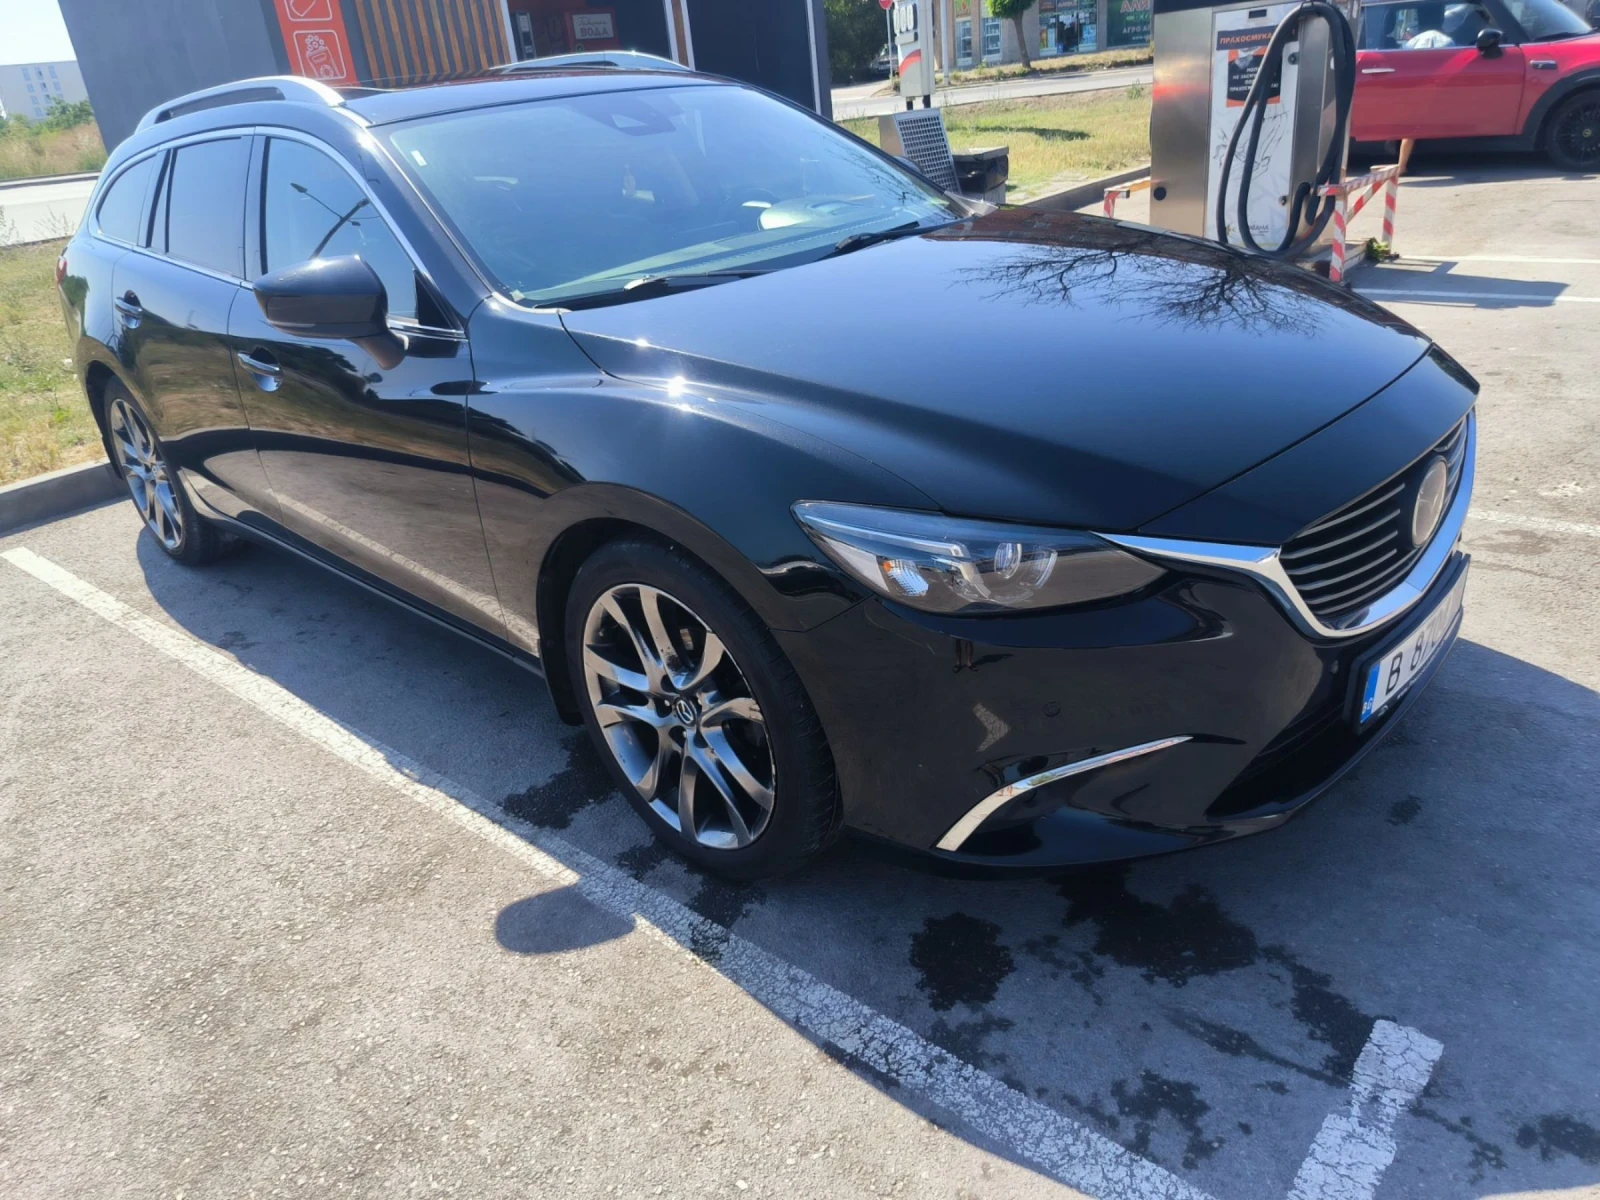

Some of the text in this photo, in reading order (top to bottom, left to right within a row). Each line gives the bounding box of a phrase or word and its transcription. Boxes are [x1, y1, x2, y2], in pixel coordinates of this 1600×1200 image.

[580, 27, 610, 37] ВОДА
[1220, 33, 1273, 45] ПРАХОСМУКА
[1386, 651, 1403, 696] B
